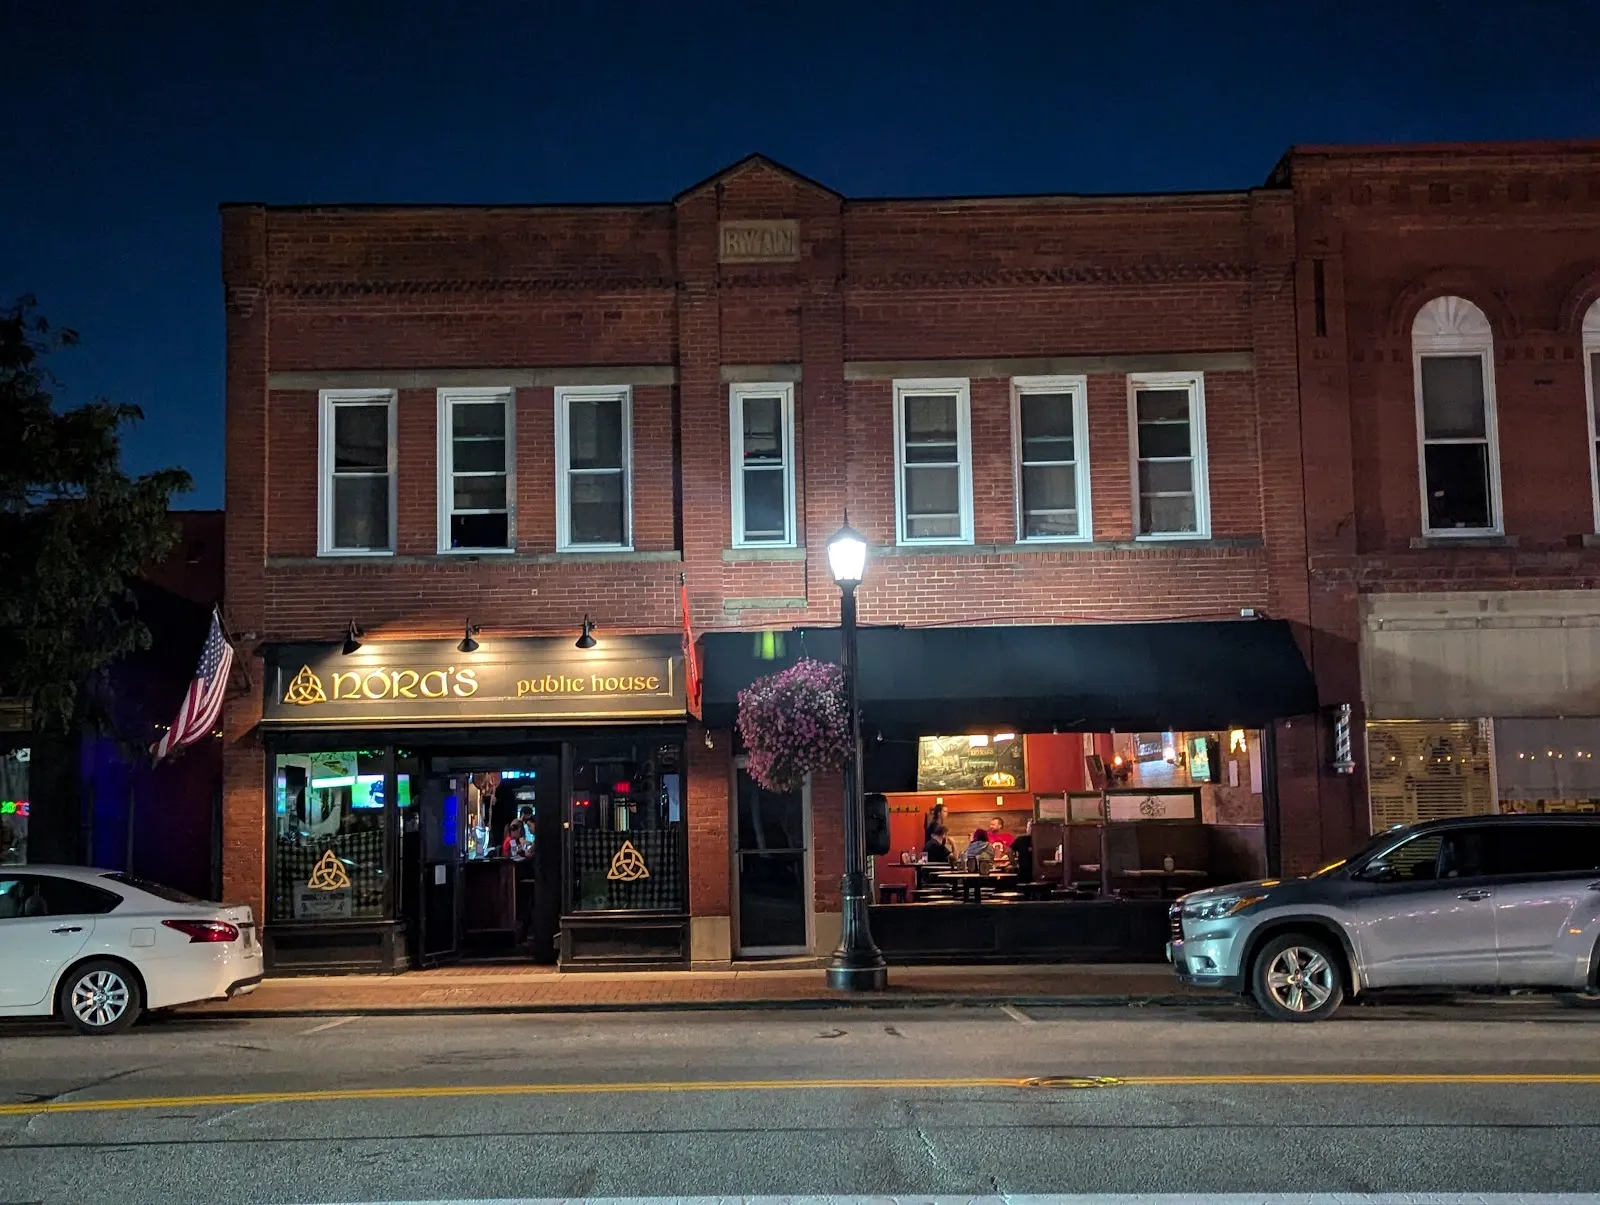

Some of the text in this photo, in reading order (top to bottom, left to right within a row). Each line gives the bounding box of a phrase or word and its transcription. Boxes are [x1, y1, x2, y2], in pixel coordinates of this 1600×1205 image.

[724, 228, 794, 257] RYAN
[516, 674, 660, 697] public house
